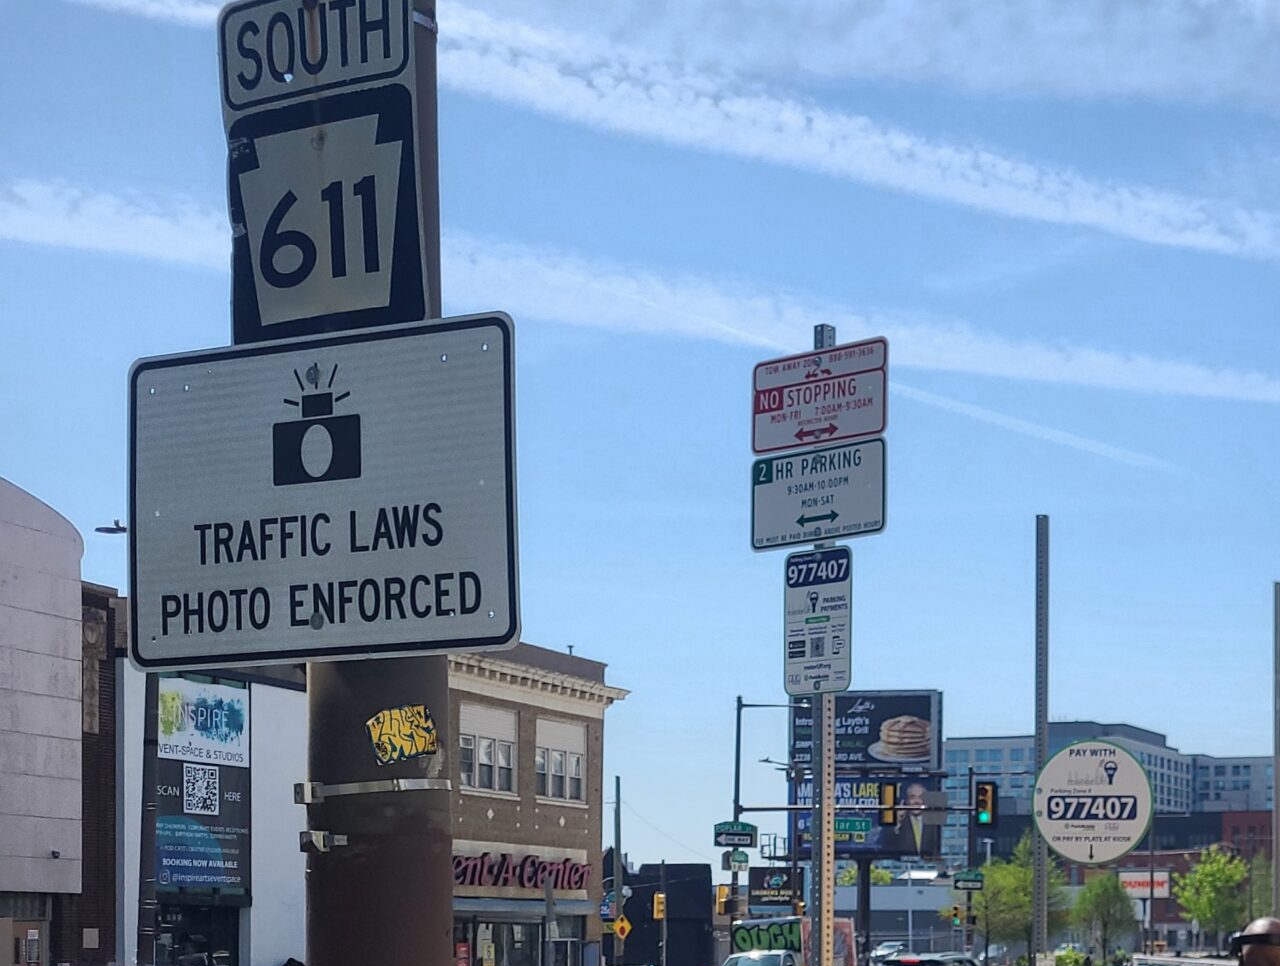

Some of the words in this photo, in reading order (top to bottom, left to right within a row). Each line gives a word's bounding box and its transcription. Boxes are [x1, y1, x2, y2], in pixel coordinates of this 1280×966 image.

[237, 0, 391, 91] SOUTH
[259, 175, 380, 288] 611
[760, 391, 779, 411] NO
[787, 378, 857, 407] STOPPING
[770, 410, 802, 424] MON-FRI
[759, 464, 767, 481] 2
[775, 461, 793, 480] HR
[801, 449, 862, 476] PARKING
[787, 476, 849, 495] 9:30AM-10:00PM
[801, 494, 835, 509] MON-SAT
[194, 511, 332, 567] TRAFFIC
[350, 502, 444, 553] LAWS
[788, 559, 848, 585] 977407
[162, 589, 271, 637] PHOTO
[289, 571, 482, 627] ENFORCED
[173, 704, 229, 728] INSPIRE
[205, 749, 212, 759] &
[213, 750, 244, 763] STUDIOS
[1069, 749, 1087, 758] PAY
[1089, 748, 1116, 757] WITH
[157, 785, 180, 796] SCAN
[224, 791, 242, 802] HERE
[1050, 797, 1135, 819] 977407
[855, 821, 866, 830] St
[162, 858, 192, 867] BOOKING
[193, 859, 208, 868] NOW
[208, 860, 238, 869] AVAILABLE
[453, 852, 593, 890] ent-A-Center
